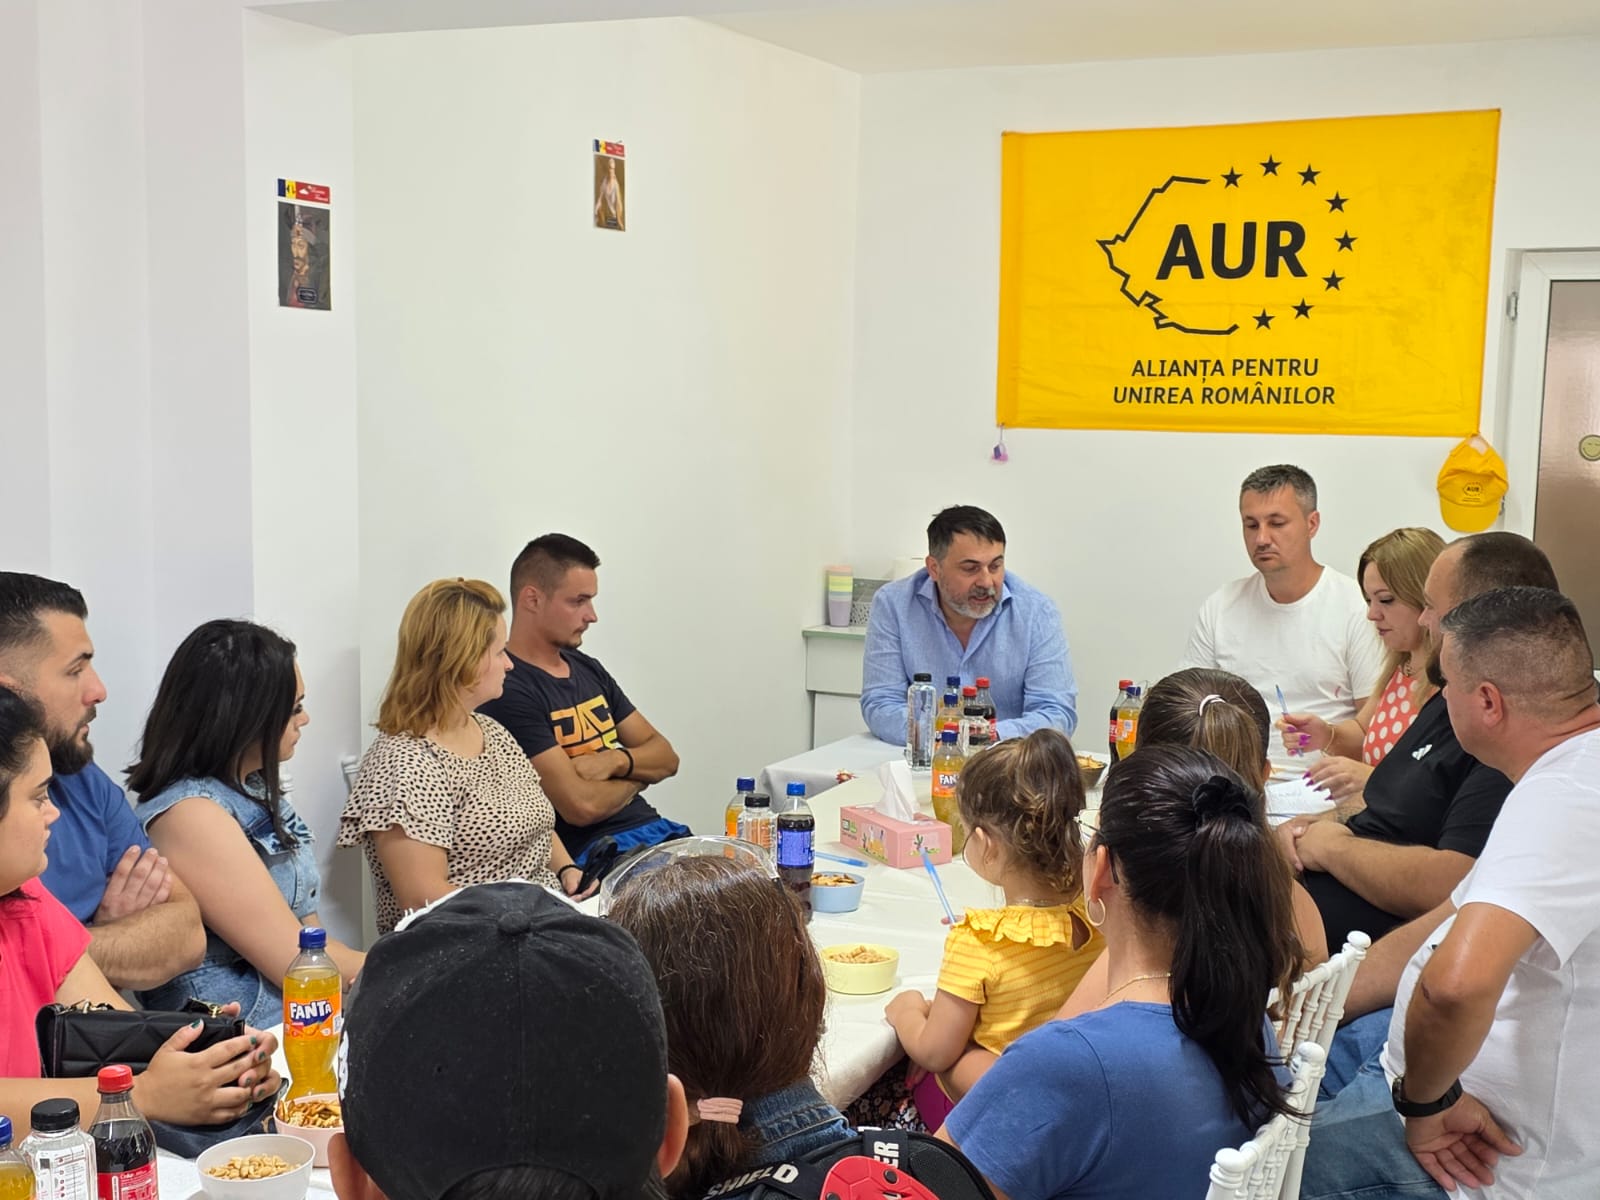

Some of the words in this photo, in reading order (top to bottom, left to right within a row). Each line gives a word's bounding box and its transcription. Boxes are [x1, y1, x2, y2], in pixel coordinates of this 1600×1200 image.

[1155, 220, 1308, 281] AUR
[1131, 359, 1225, 383] ALIANȚA
[1231, 358, 1319, 377] PENTRU
[1113, 386, 1194, 405] UNIREA
[1201, 381, 1336, 405] ROMÂNILOR
[939, 774, 959, 785] FAN
[289, 1000, 332, 1020] FANTA
